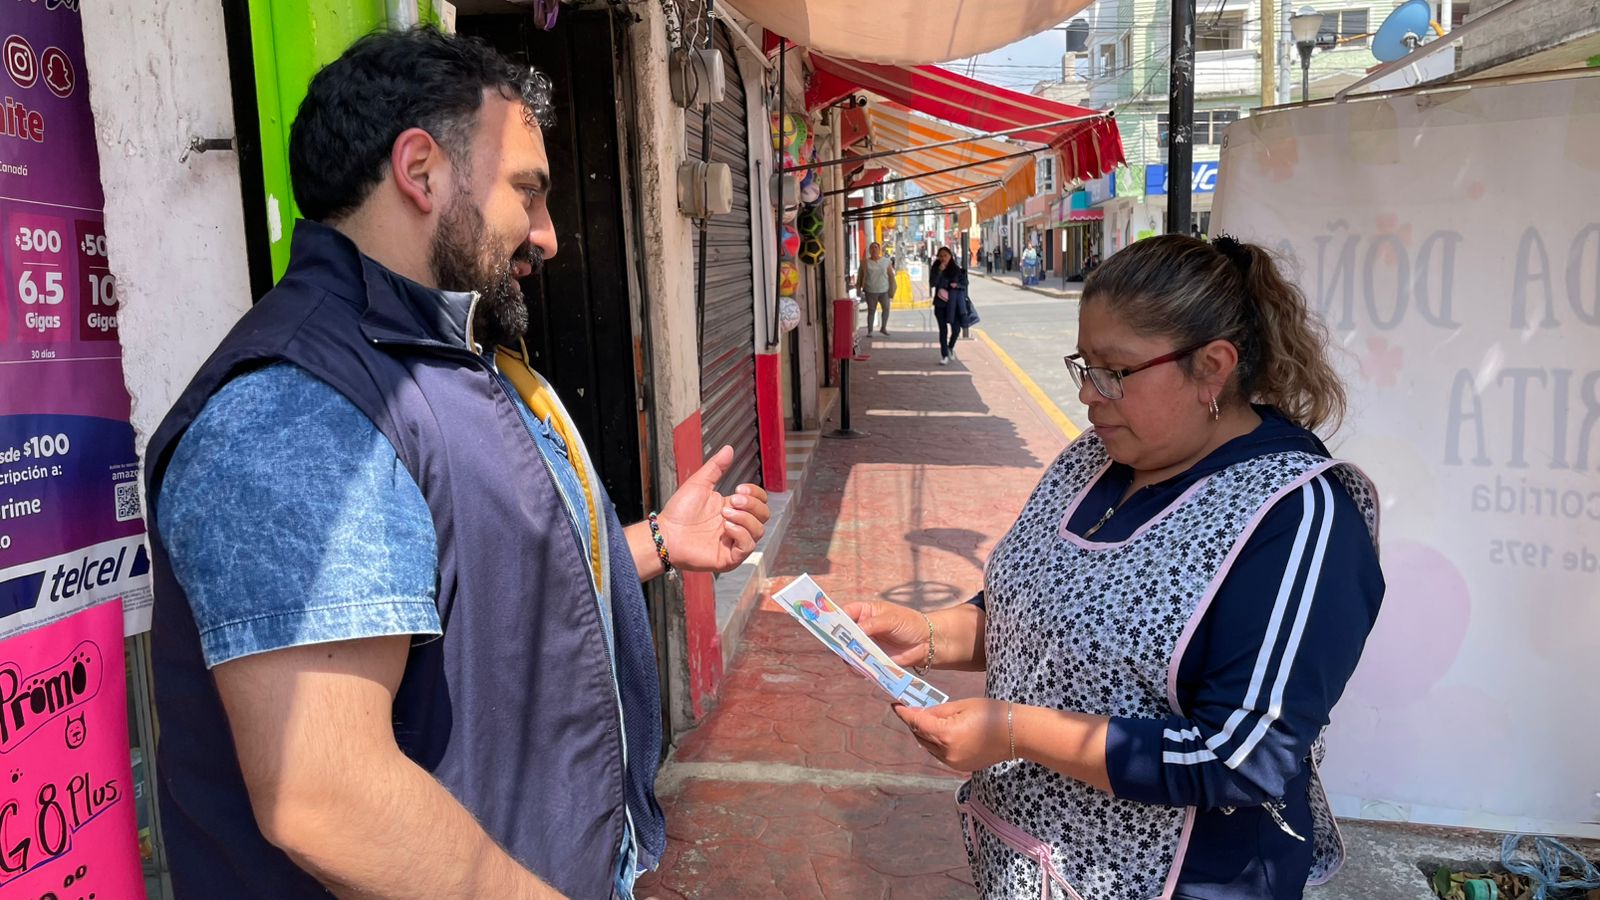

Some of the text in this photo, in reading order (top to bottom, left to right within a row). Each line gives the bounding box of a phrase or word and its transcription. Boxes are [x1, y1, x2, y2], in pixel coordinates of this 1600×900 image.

[16, 227, 61, 253] $300
[18, 271, 64, 305] 6.5
[88, 274, 119, 306] 10
[25, 312, 61, 332] Gigas
[87, 313, 119, 332] Giga
[31, 349, 56, 359] 30 días
[23, 433, 70, 459] $100
[51, 464, 62, 477] a:
[0, 498, 41, 520] rime
[50, 546, 127, 602] telcel
[66, 772, 118, 828] Plus
